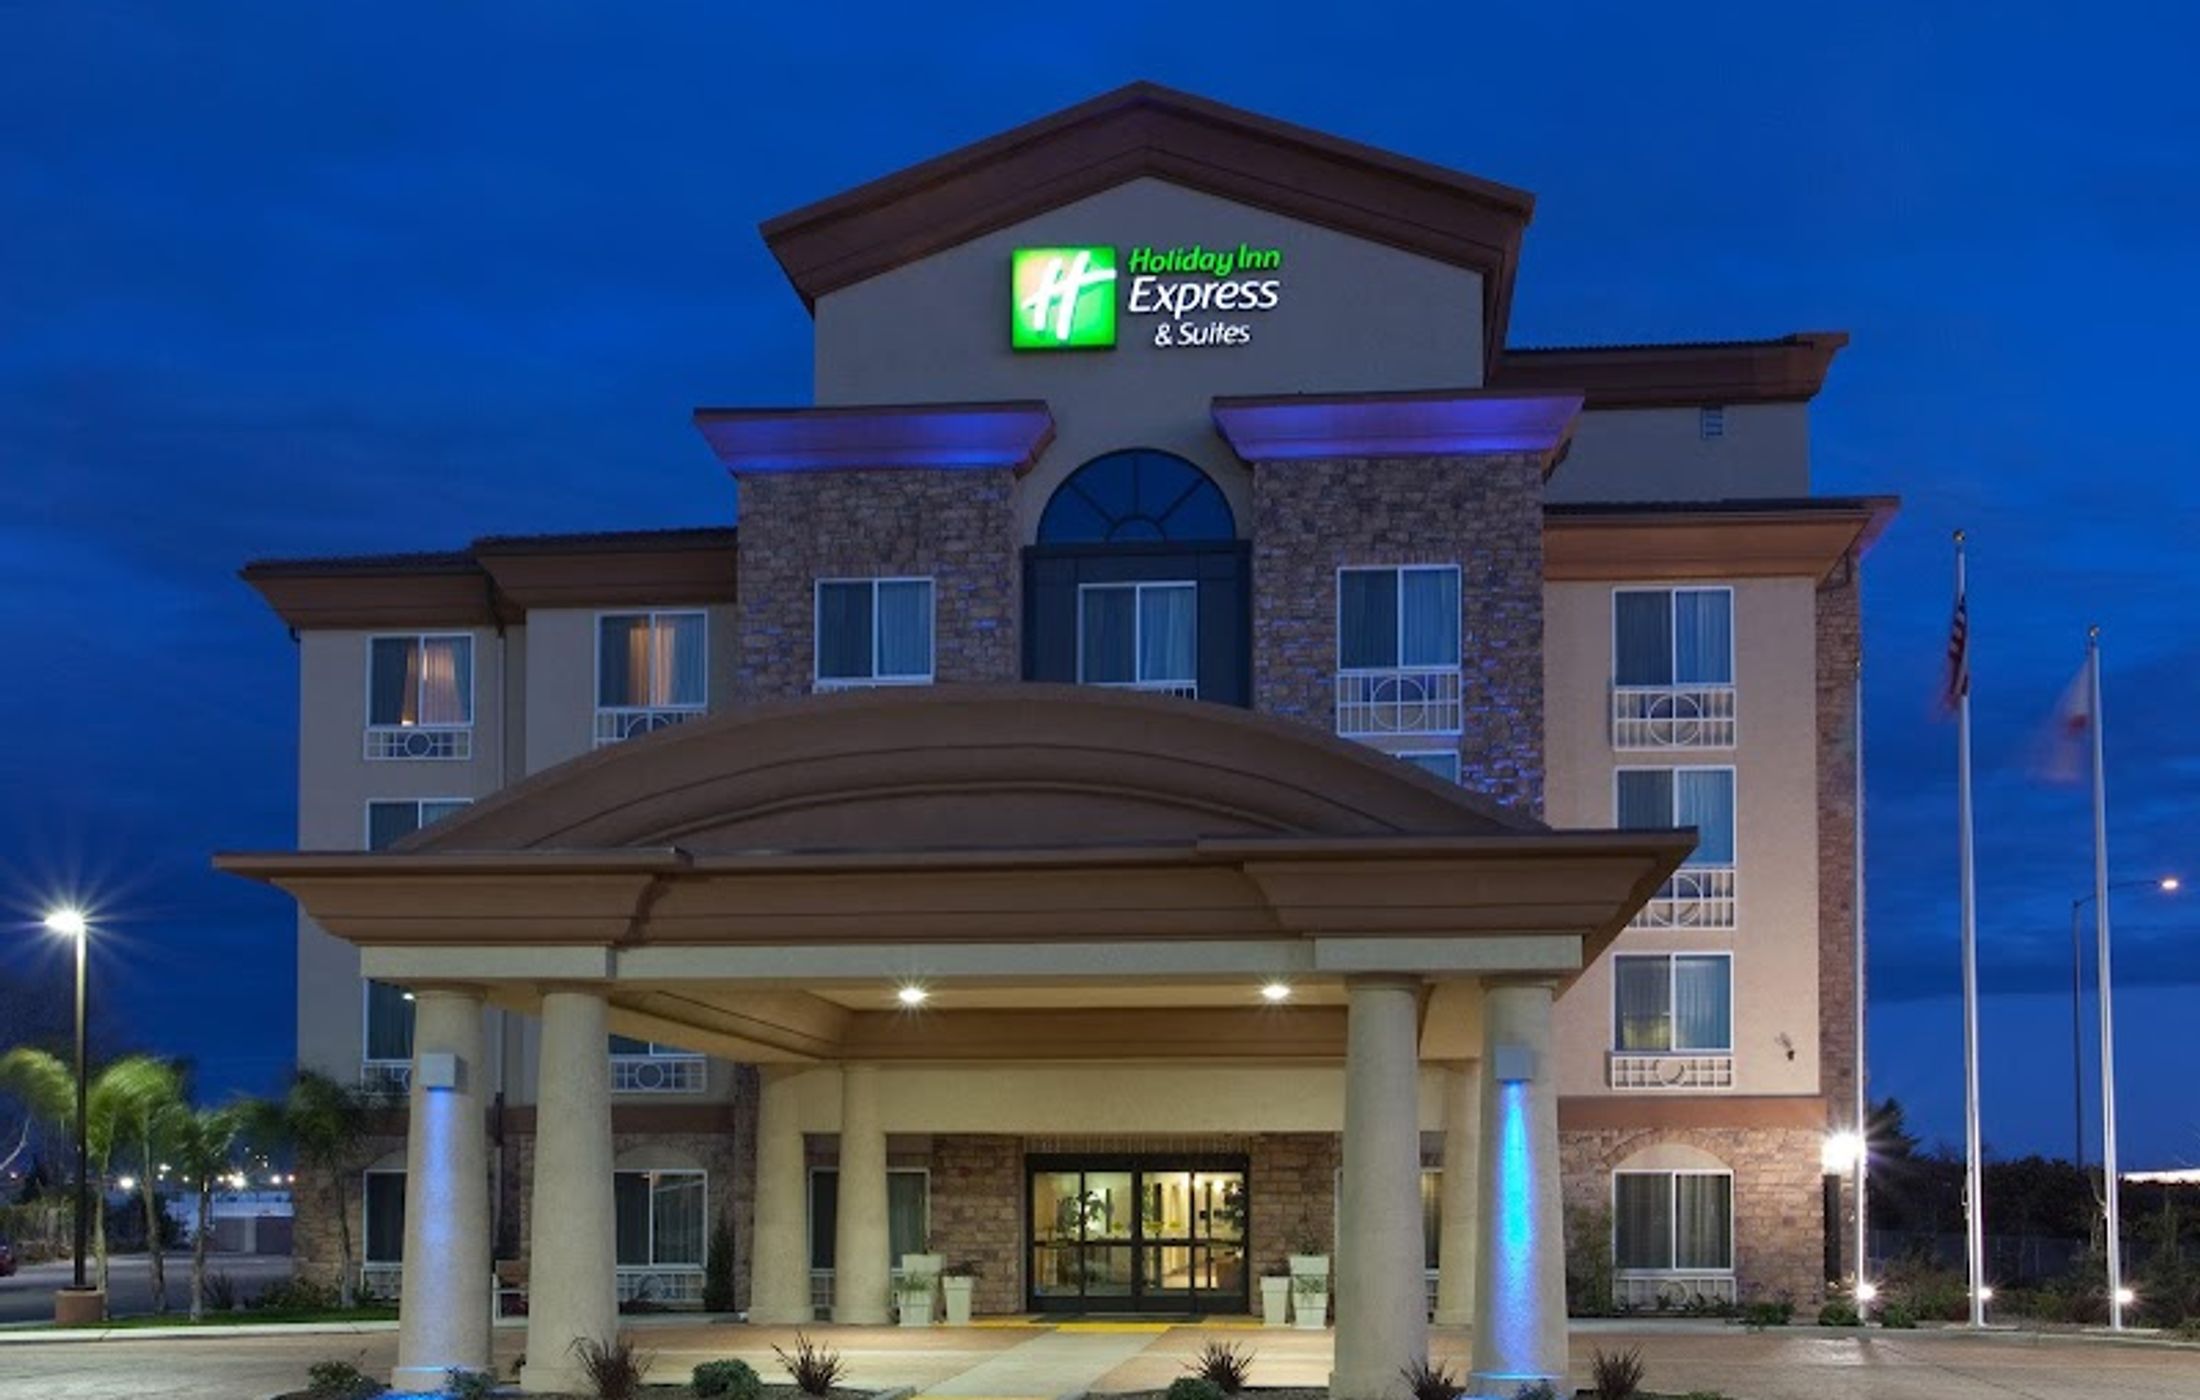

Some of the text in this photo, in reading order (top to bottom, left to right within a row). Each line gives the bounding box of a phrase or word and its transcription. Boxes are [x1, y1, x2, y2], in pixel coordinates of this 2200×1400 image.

[1128, 242, 1282, 276] Holiday Inn
[1127, 275, 1281, 320] Express
[1154, 321, 1251, 347] & Suites
